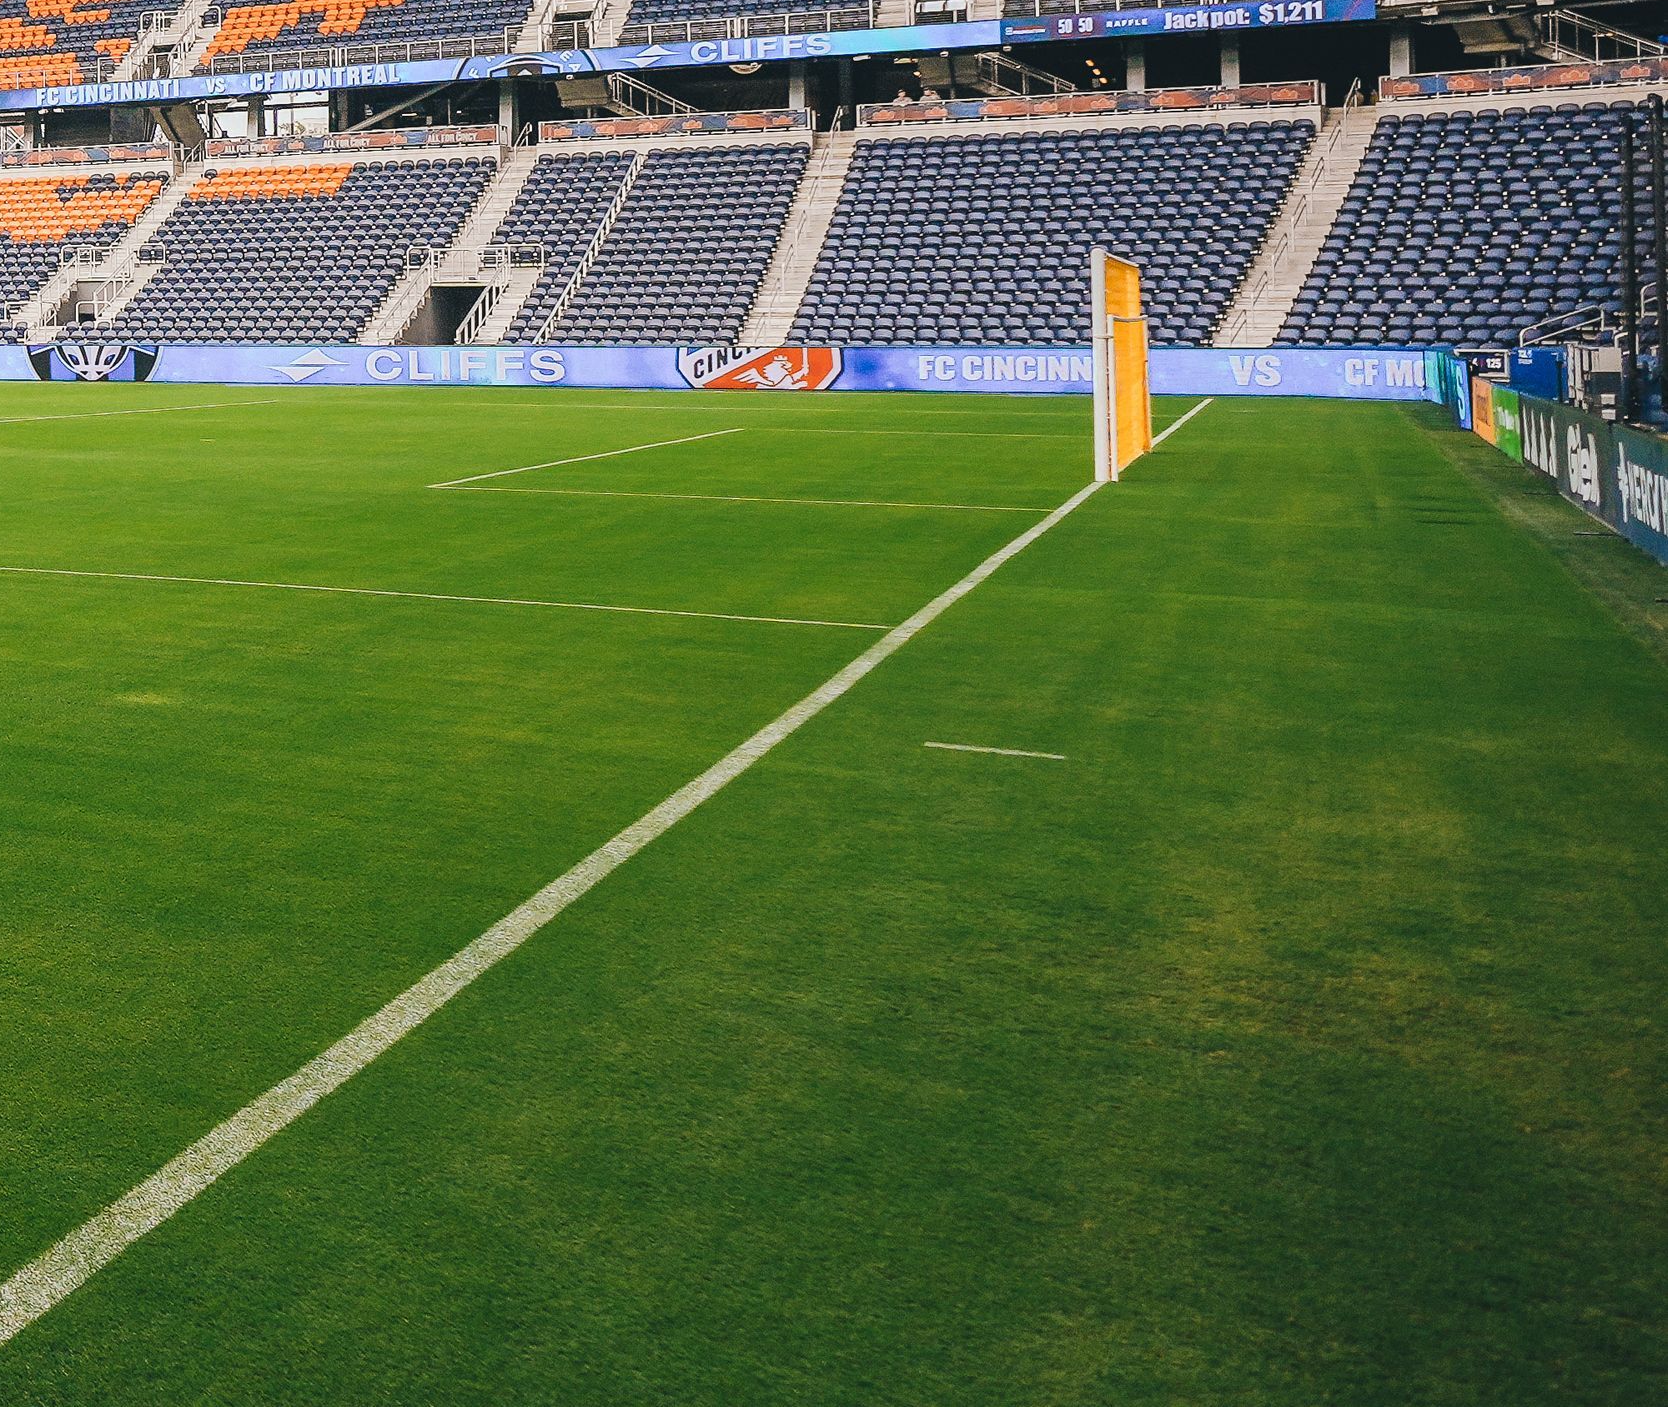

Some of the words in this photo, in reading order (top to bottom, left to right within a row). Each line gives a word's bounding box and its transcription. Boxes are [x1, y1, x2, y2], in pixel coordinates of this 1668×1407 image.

[1058, 18, 1073, 34] 50
[1078, 17, 1093, 33] 50
[1106, 18, 1148, 28] RAFFLE
[1164, 7, 1250, 31] Jackpot:
[1259, 0, 1324, 25] $1,211
[690, 34, 831, 63] CLIFFS
[36, 87, 61, 107] FC
[66, 79, 180, 106] CINCINNATI
[206, 77, 225, 94] VS
[249, 72, 277, 92] CF
[281, 63, 400, 91] MONTREAL
[366, 349, 565, 382] CLIFFS
[919, 356, 955, 380] FC
[1228, 355, 1282, 387] VS
[1344, 358, 1380, 384] CF
[1486, 358, 1502, 369] 125
